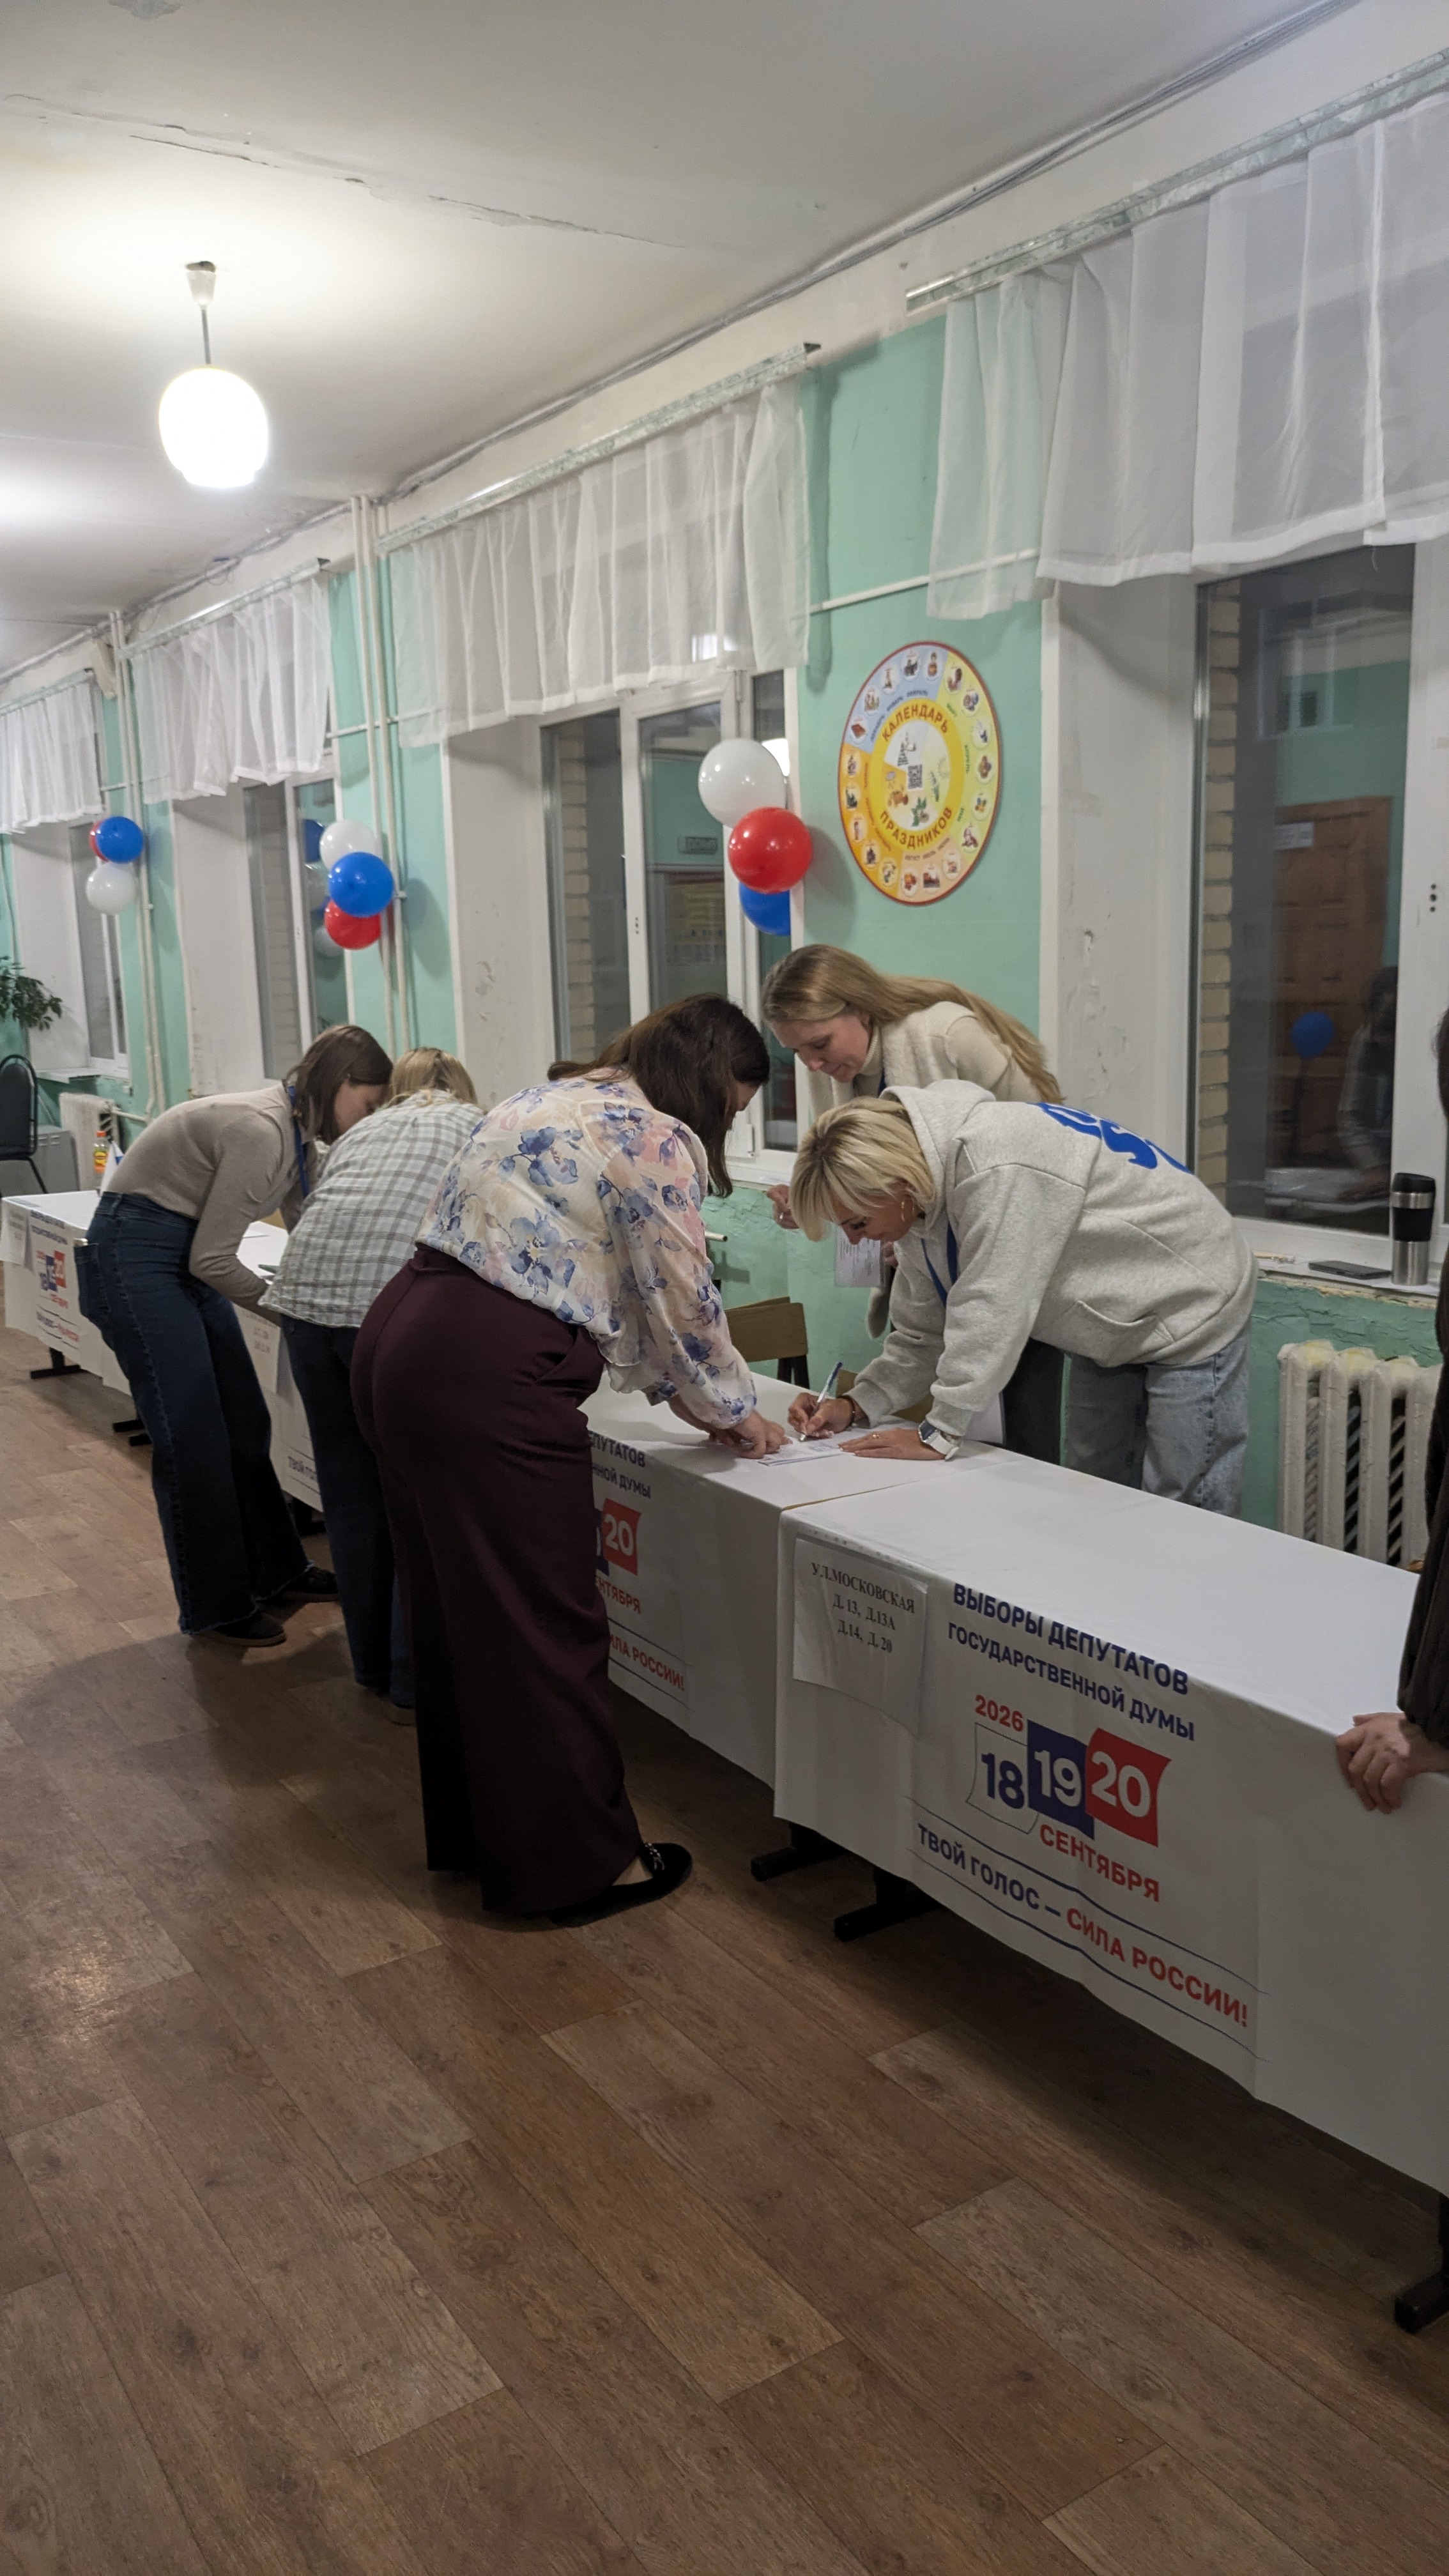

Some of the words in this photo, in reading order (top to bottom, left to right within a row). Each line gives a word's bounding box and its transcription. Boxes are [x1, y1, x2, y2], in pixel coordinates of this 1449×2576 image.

[882, 705, 947, 742] КАЛЕНДАРЬ
[880, 807, 952, 850] ПРАЗДНИКОВ
[588, 1430, 645, 1468] ПУТАТОВ
[619, 1473, 651, 1499] ДУМЫ
[604, 1514, 634, 1556] 20
[953, 1583, 1044, 1637] ВЫБОРЫ
[1048, 1621, 1189, 1696] ДЕПУТАТОВ
[632, 1646, 685, 1692] РОССИИ!
[948, 1621, 1125, 1713] ГОСУДАРСТВЕННОЙ
[1130, 1698, 1195, 1742] ДУМЫ
[975, 1694, 1024, 1733] 2026
[981, 1752, 1025, 1810] 18
[1034, 1749, 1083, 1808] 19
[1091, 1751, 1152, 1818] 20
[1039, 1823, 1161, 1903] СЕНТЯБРЯ
[917, 1823, 966, 1871] ТВОЙ
[971, 1855, 1040, 1910] ГОЛОС
[1066, 1908, 1126, 1963] СИЛА
[1131, 1945, 1249, 2028] РОССИИ!
